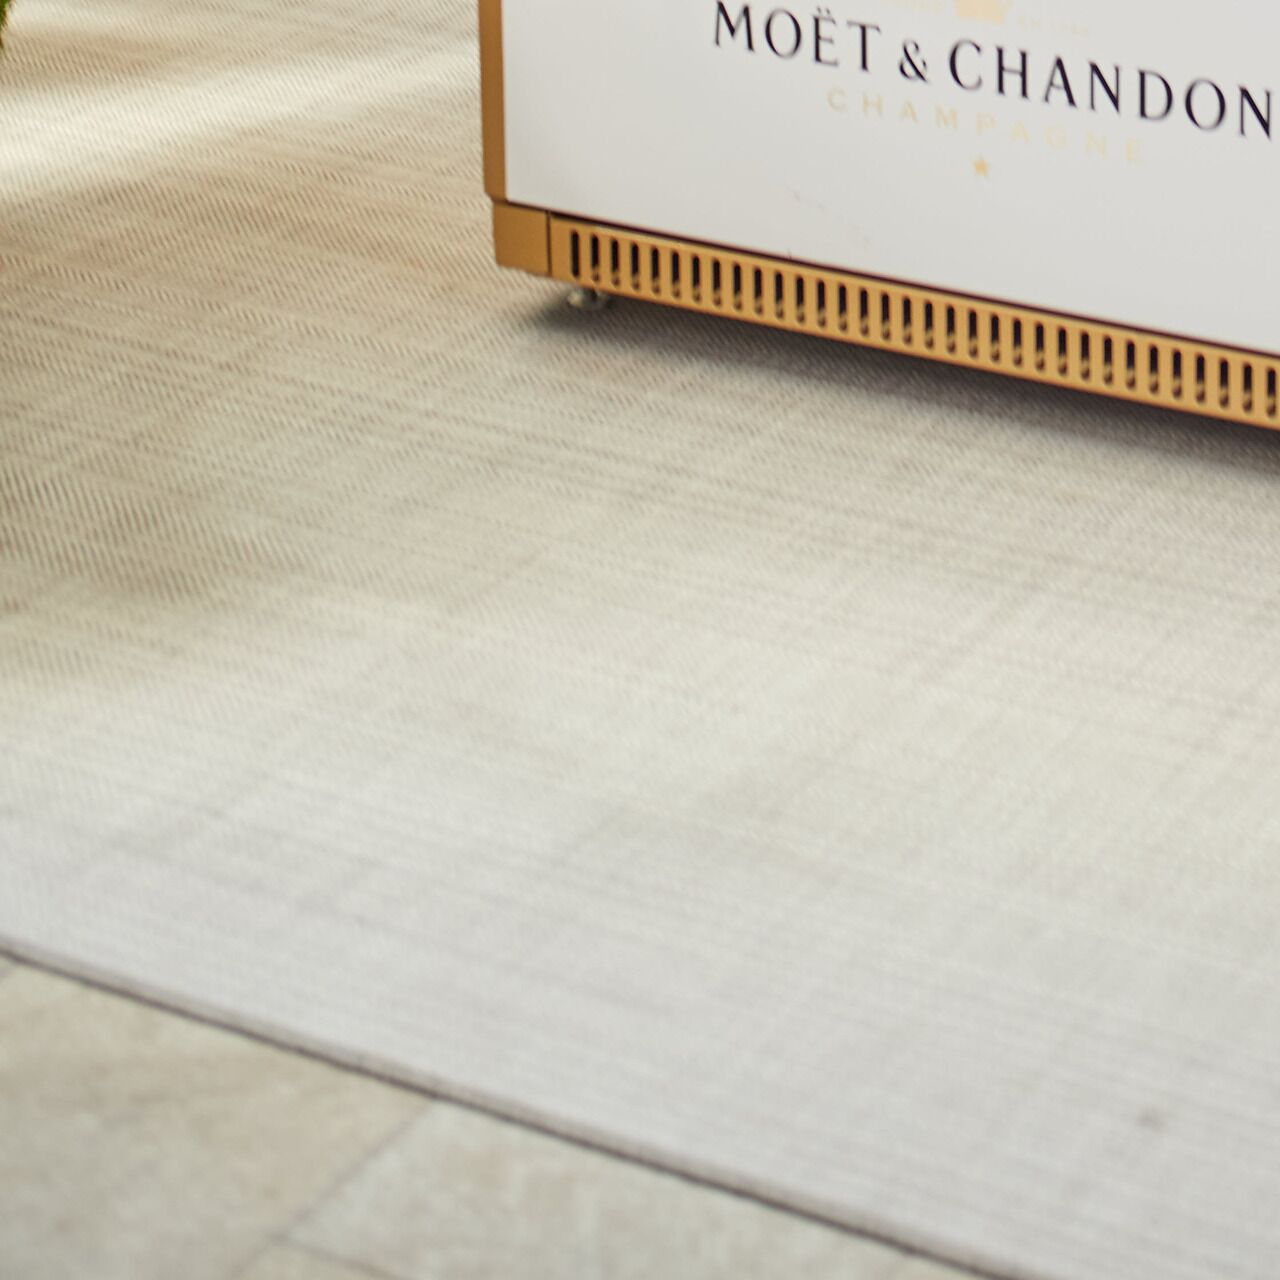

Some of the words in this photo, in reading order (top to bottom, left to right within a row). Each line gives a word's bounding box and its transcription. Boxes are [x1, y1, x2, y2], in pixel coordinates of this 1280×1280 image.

[713, 0, 881, 72] MOËT
[899, 40, 929, 84] &
[948, 38, 1273, 140] CHANDON
[827, 87, 1145, 164] CHAMPAGNE
